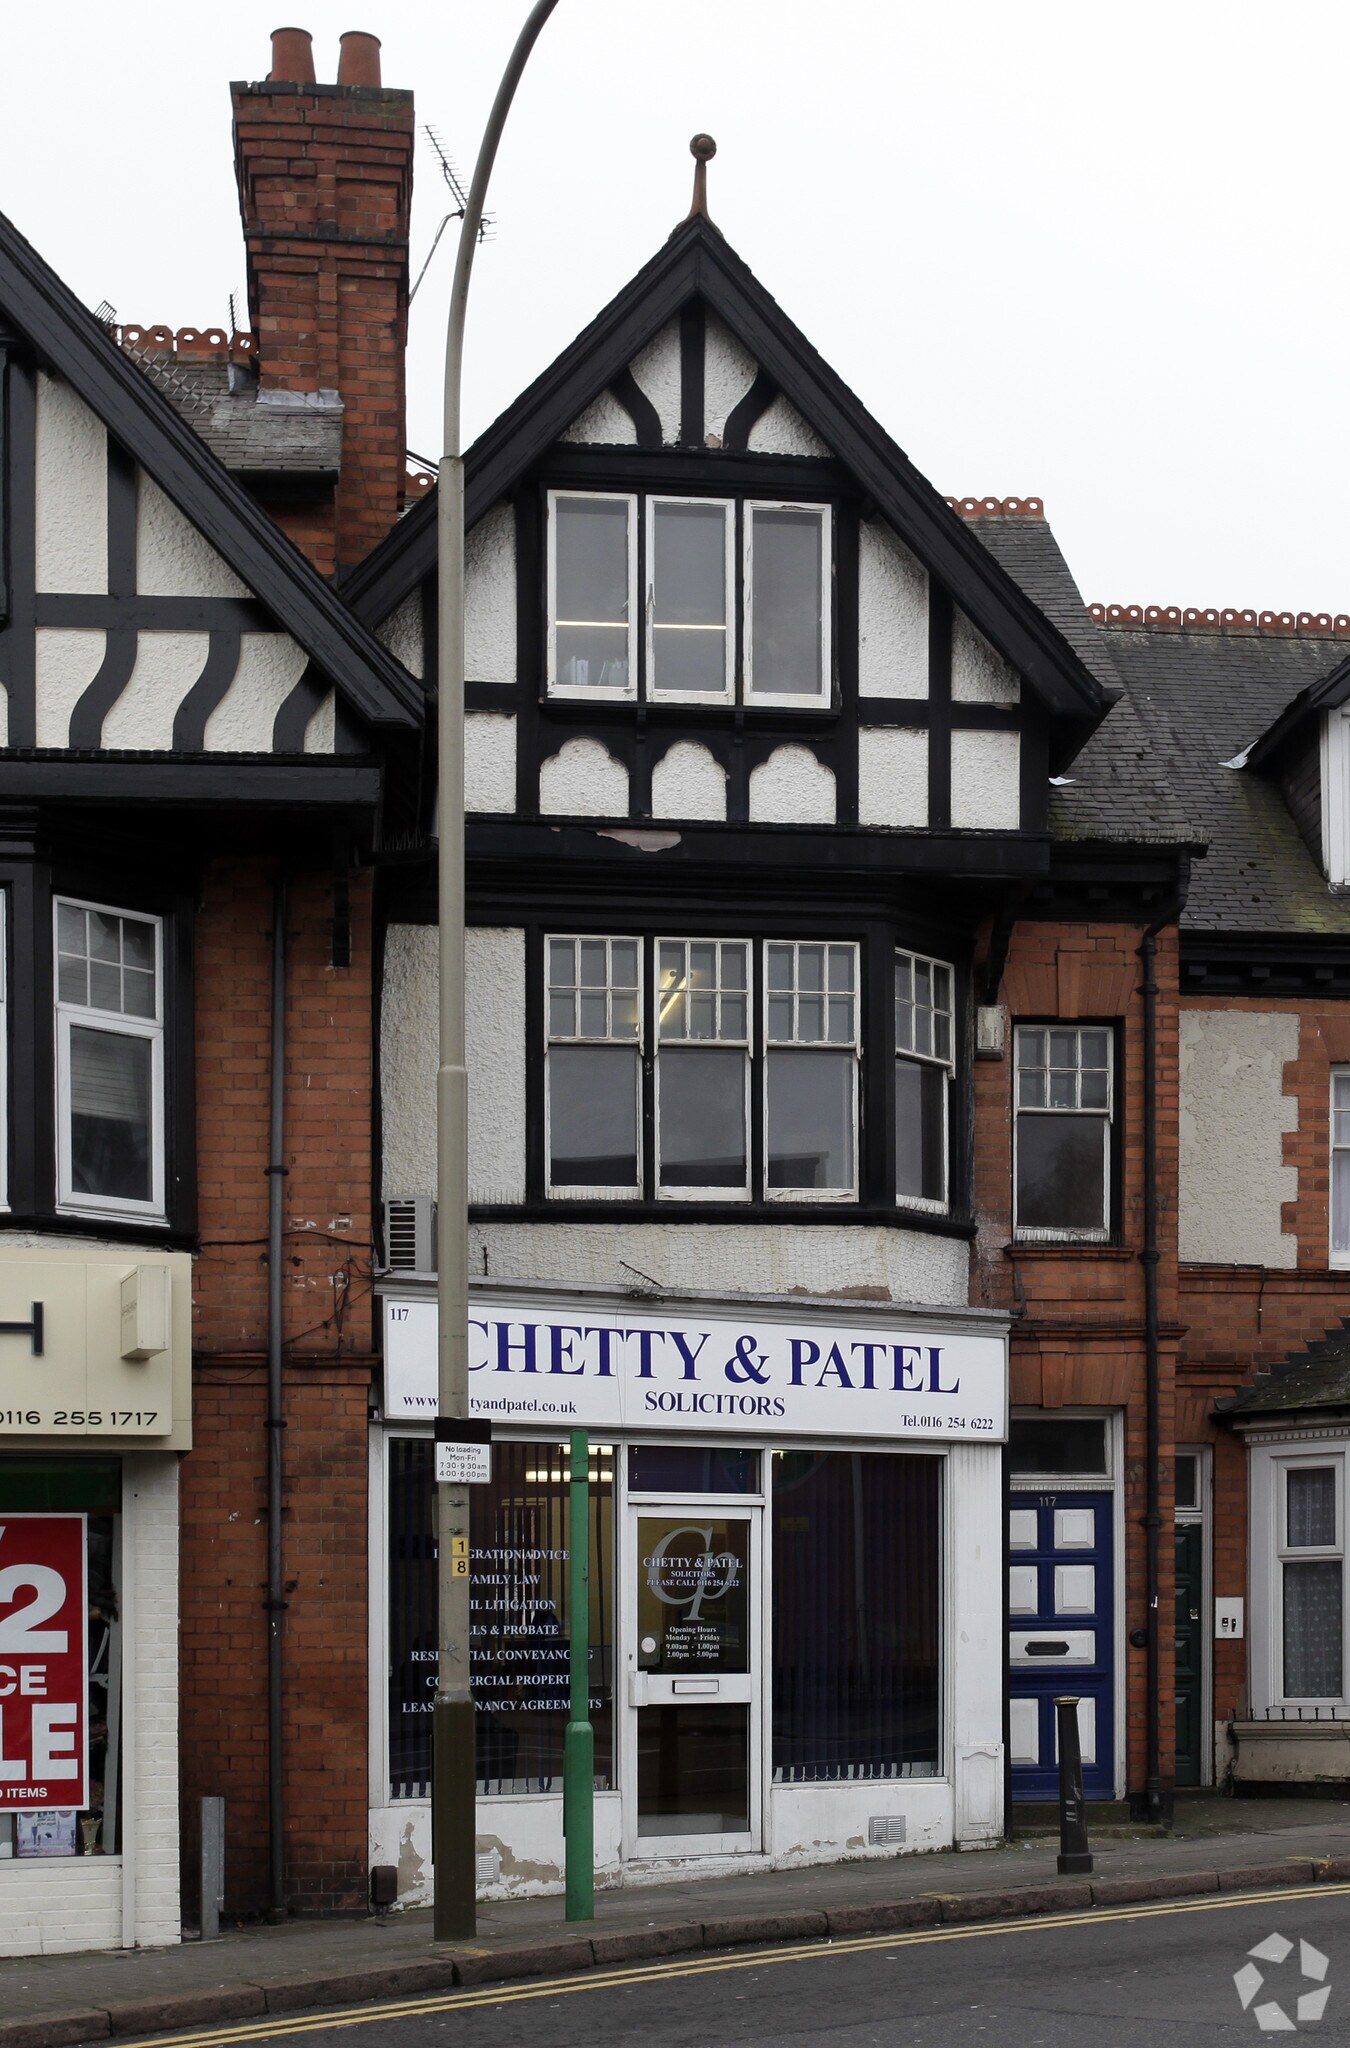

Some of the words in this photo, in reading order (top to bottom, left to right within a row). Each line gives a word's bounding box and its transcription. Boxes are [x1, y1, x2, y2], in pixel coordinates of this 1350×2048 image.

[390, 1308, 409, 1322] 117
[724, 1335, 771, 1385] &
[786, 1338, 961, 1394] PATEL
[403, 1397, 577, 1413] wwwtyandpatel.co.uk
[644, 1391, 786, 1417] SOLICITORS
[0, 1411, 41, 1425] 116
[53, 1411, 103, 1425] 255
[110, 1411, 158, 1426] 1717
[901, 1414, 943, 1428] Tel.0116
[947, 1417, 966, 1429] 254
[970, 1418, 994, 1430] 6222
[456, 1446, 481, 1454] loading
[1040, 1496, 1057, 1507] 117
[458, 1541, 465, 1553] 1
[433, 1548, 522, 1560] IGRATION
[525, 1549, 571, 1560] ADVICE
[457, 1561, 466, 1574] 8
[643, 1557, 692, 1568] CHETTY
[694, 1557, 704, 1568] &
[707, 1558, 743, 1569] PATEL
[514, 1575, 541, 1585] LAW
[671, 1570, 716, 1578] SOLICITORS
[647, 1579, 675, 1587] PLEASE
[676, 1579, 697, 1587] CALL
[485, 1600, 557, 1611] LITIGATION
[490, 1625, 500, 1635] &
[503, 1625, 560, 1635] PROBATE
[669, 1626, 697, 1634] Opening
[665, 1634, 691, 1642] Monday
[700, 1634, 720, 1642] Friday
[411, 1650, 494, 1661] RESIIAL
[496, 1649, 594, 1661] CONVEYANCG
[425, 1675, 513, 1687] CERCIAL
[516, 1674, 571, 1685] PROPERT
[402, 1702, 435, 1713] LEAS
[519, 1698, 602, 1710] AGREEMTS
[7, 1787, 48, 1798] ITEMS
